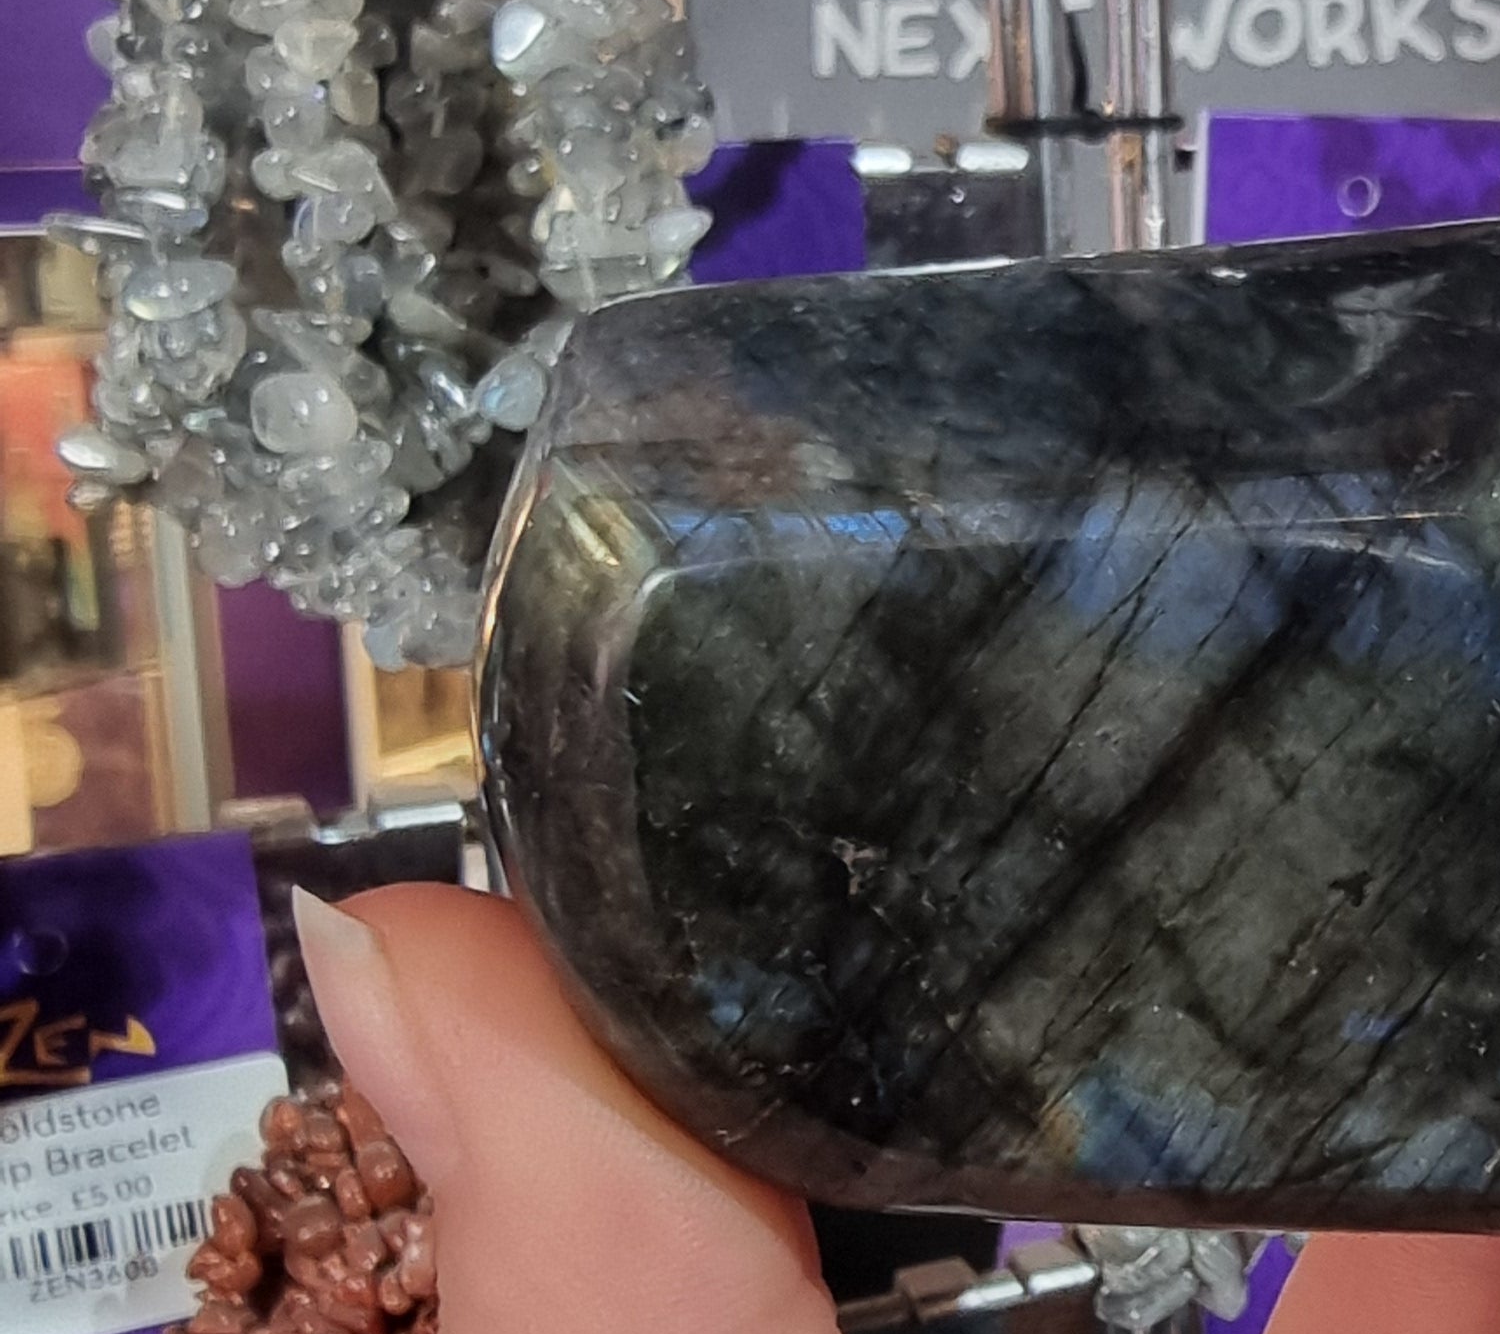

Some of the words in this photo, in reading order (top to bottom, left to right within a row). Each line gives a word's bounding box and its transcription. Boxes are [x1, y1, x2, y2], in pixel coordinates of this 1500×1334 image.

[0, 1093, 161, 1144] oldstone
[45, 1125, 195, 1177] Bracelet
[71, 1174, 154, 1211] £5.00
